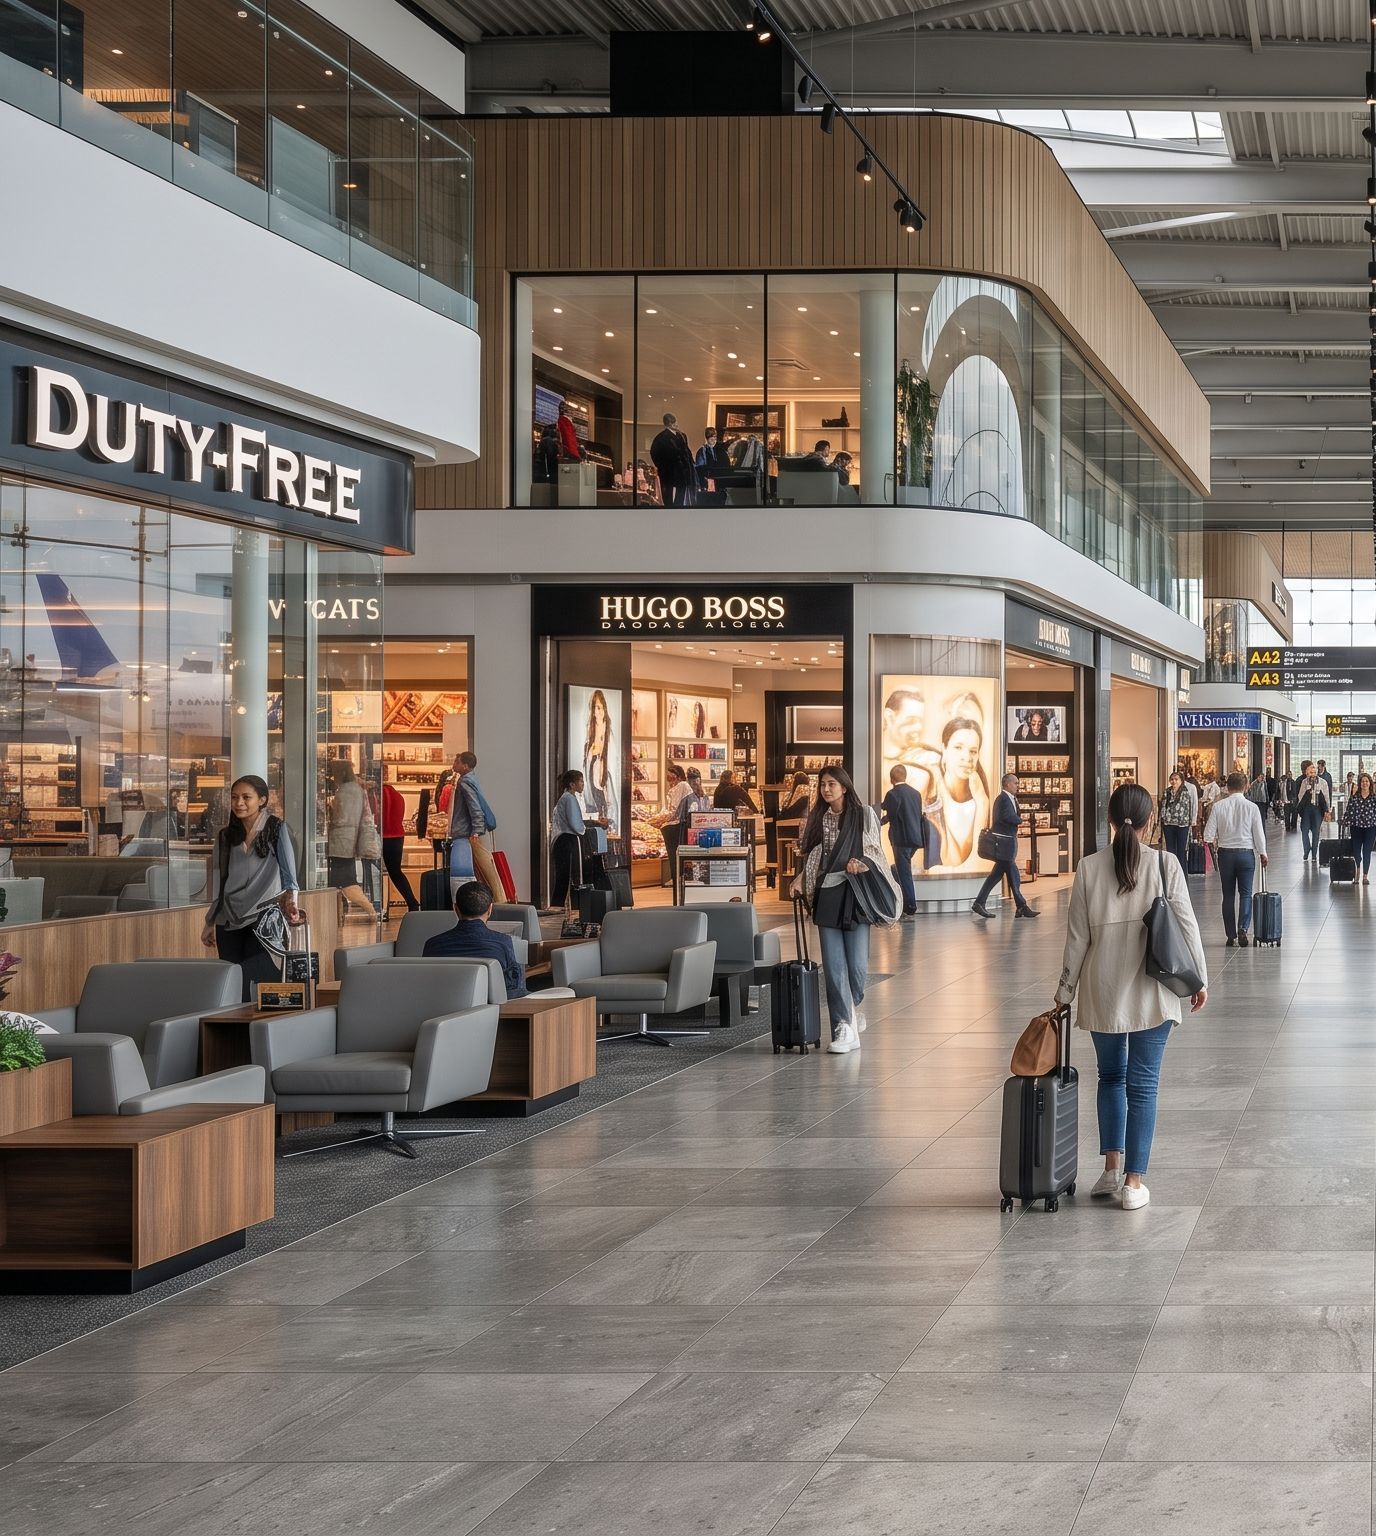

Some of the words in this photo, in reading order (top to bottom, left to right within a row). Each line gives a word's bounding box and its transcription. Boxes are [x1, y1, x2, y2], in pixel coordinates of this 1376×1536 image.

[600, 596, 693, 620] HUGO
[702, 596, 785, 620] BOSS
[1250, 650, 1281, 665] A42
[1249, 672, 1281, 686] A43
